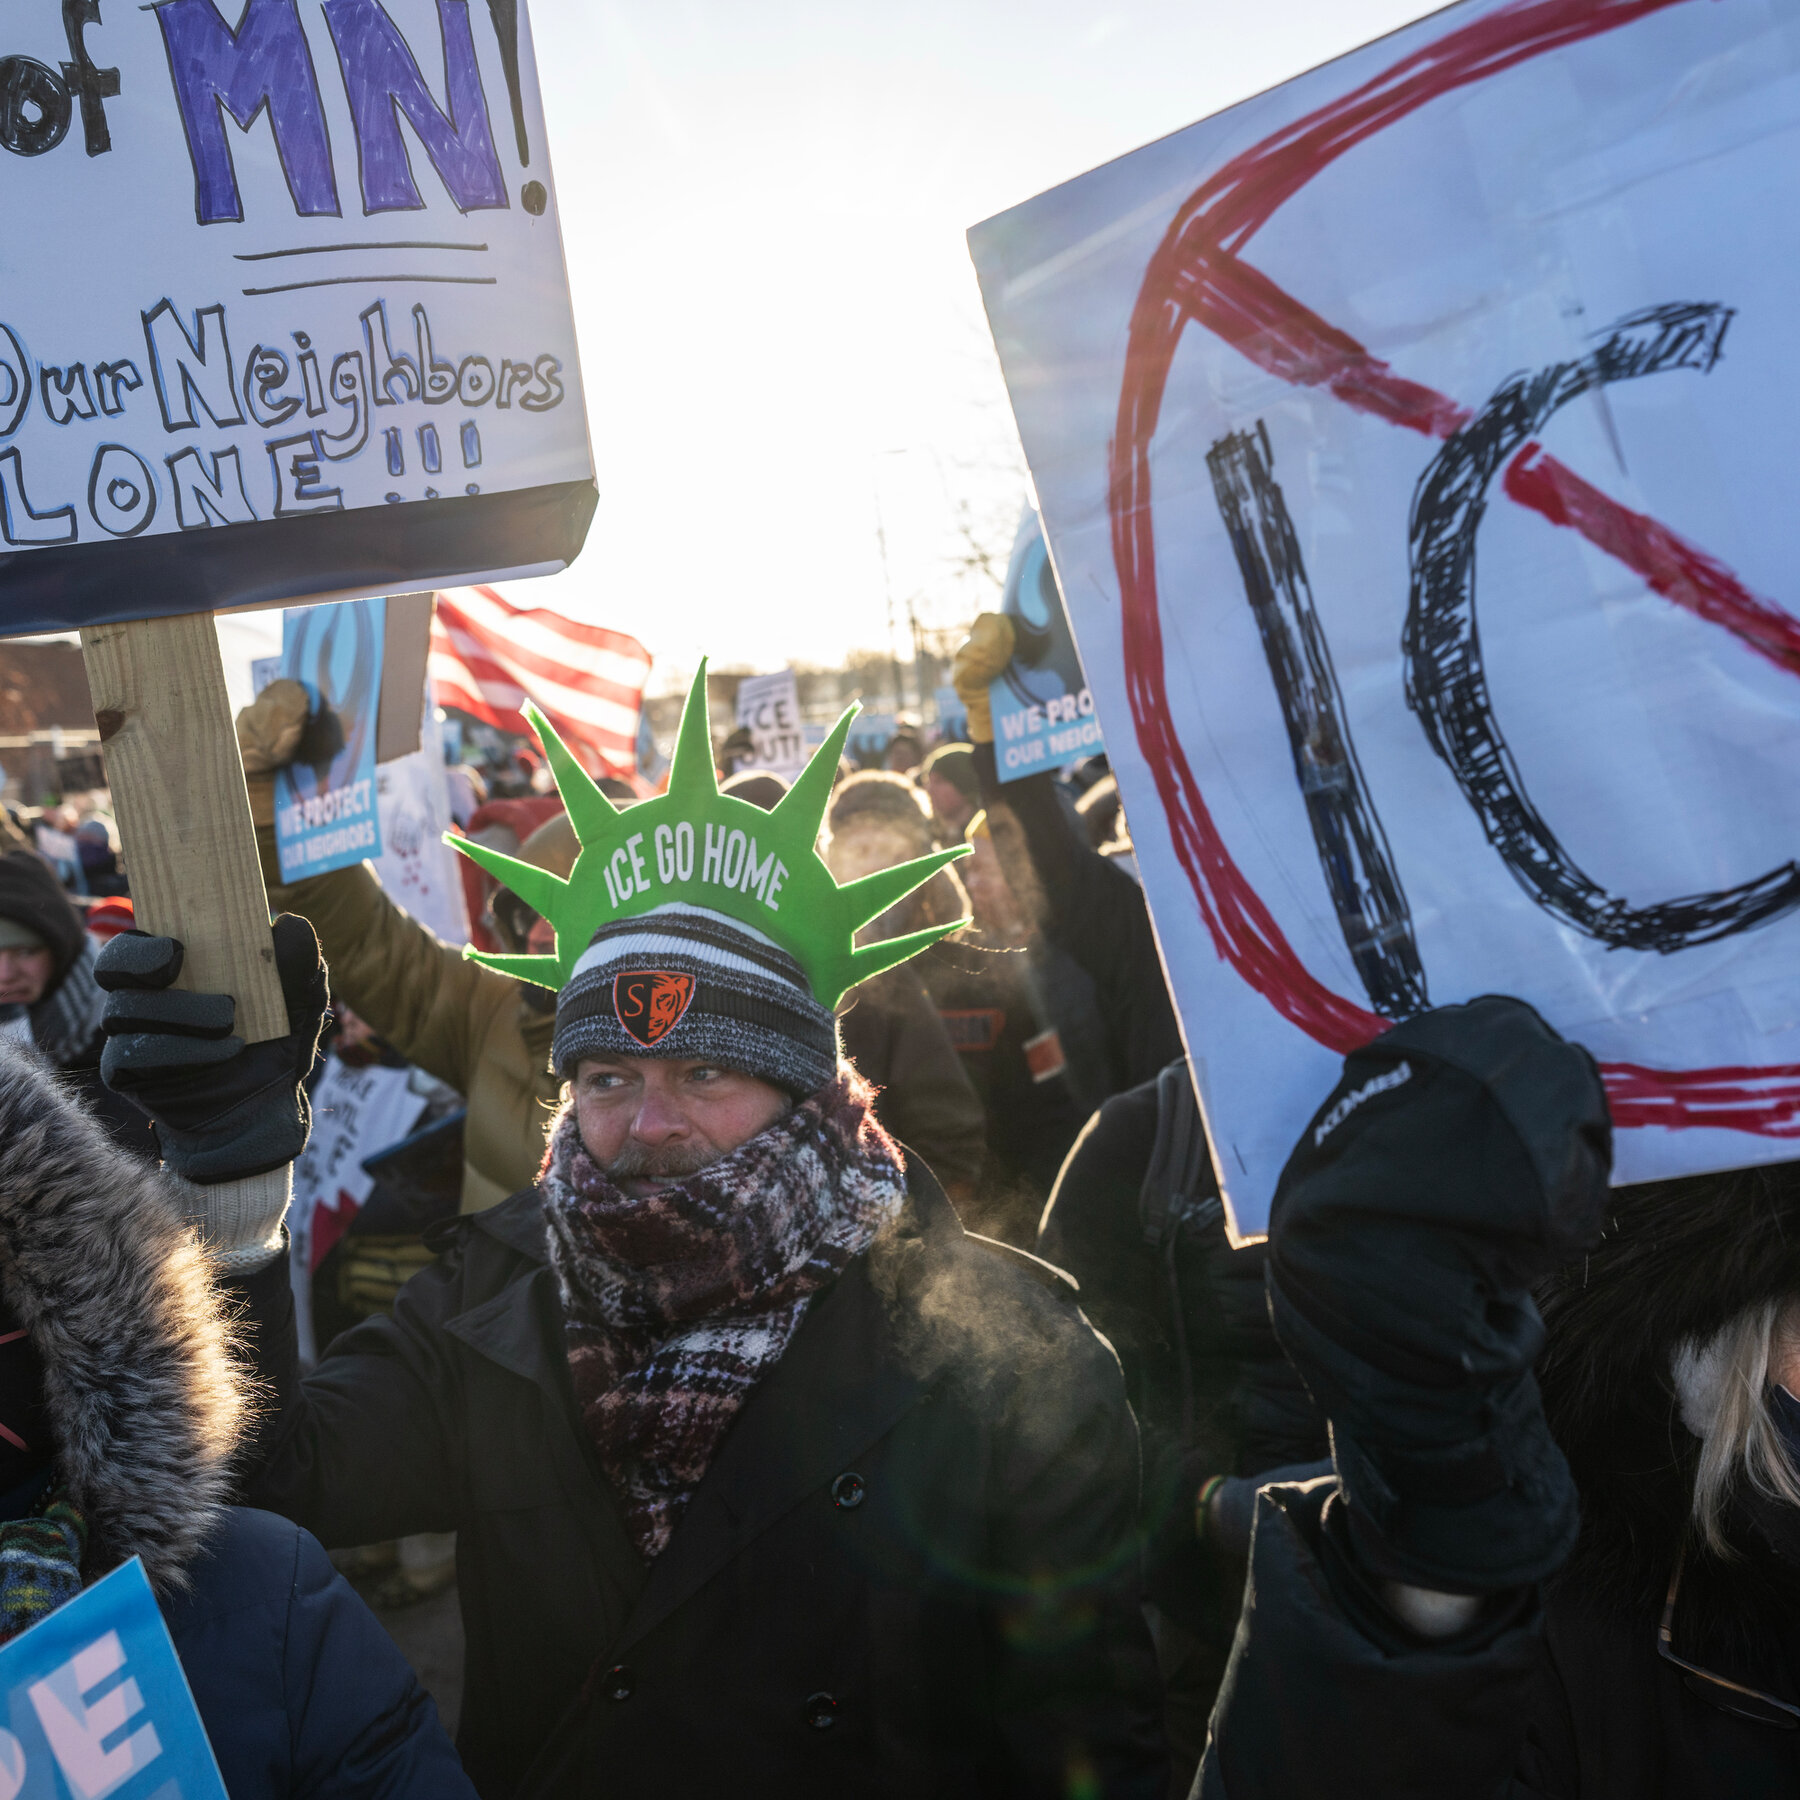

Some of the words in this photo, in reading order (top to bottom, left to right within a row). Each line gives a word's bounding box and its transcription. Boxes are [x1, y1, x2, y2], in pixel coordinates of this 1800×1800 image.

[0, 0, 121, 157] of
[138, 0, 547, 224] MN!
[140, 297, 564, 460] Neighbors
[1002, 705, 1042, 741] WE
[1046, 687, 1095, 728] PRO
[1004, 739, 1046, 769] OUR
[303, 778, 372, 827] PROTECT
[603, 832, 651, 909] ICE
[654, 821, 695, 884] GO
[702, 822, 790, 912] HOME
[624, 983, 645, 1017] S
